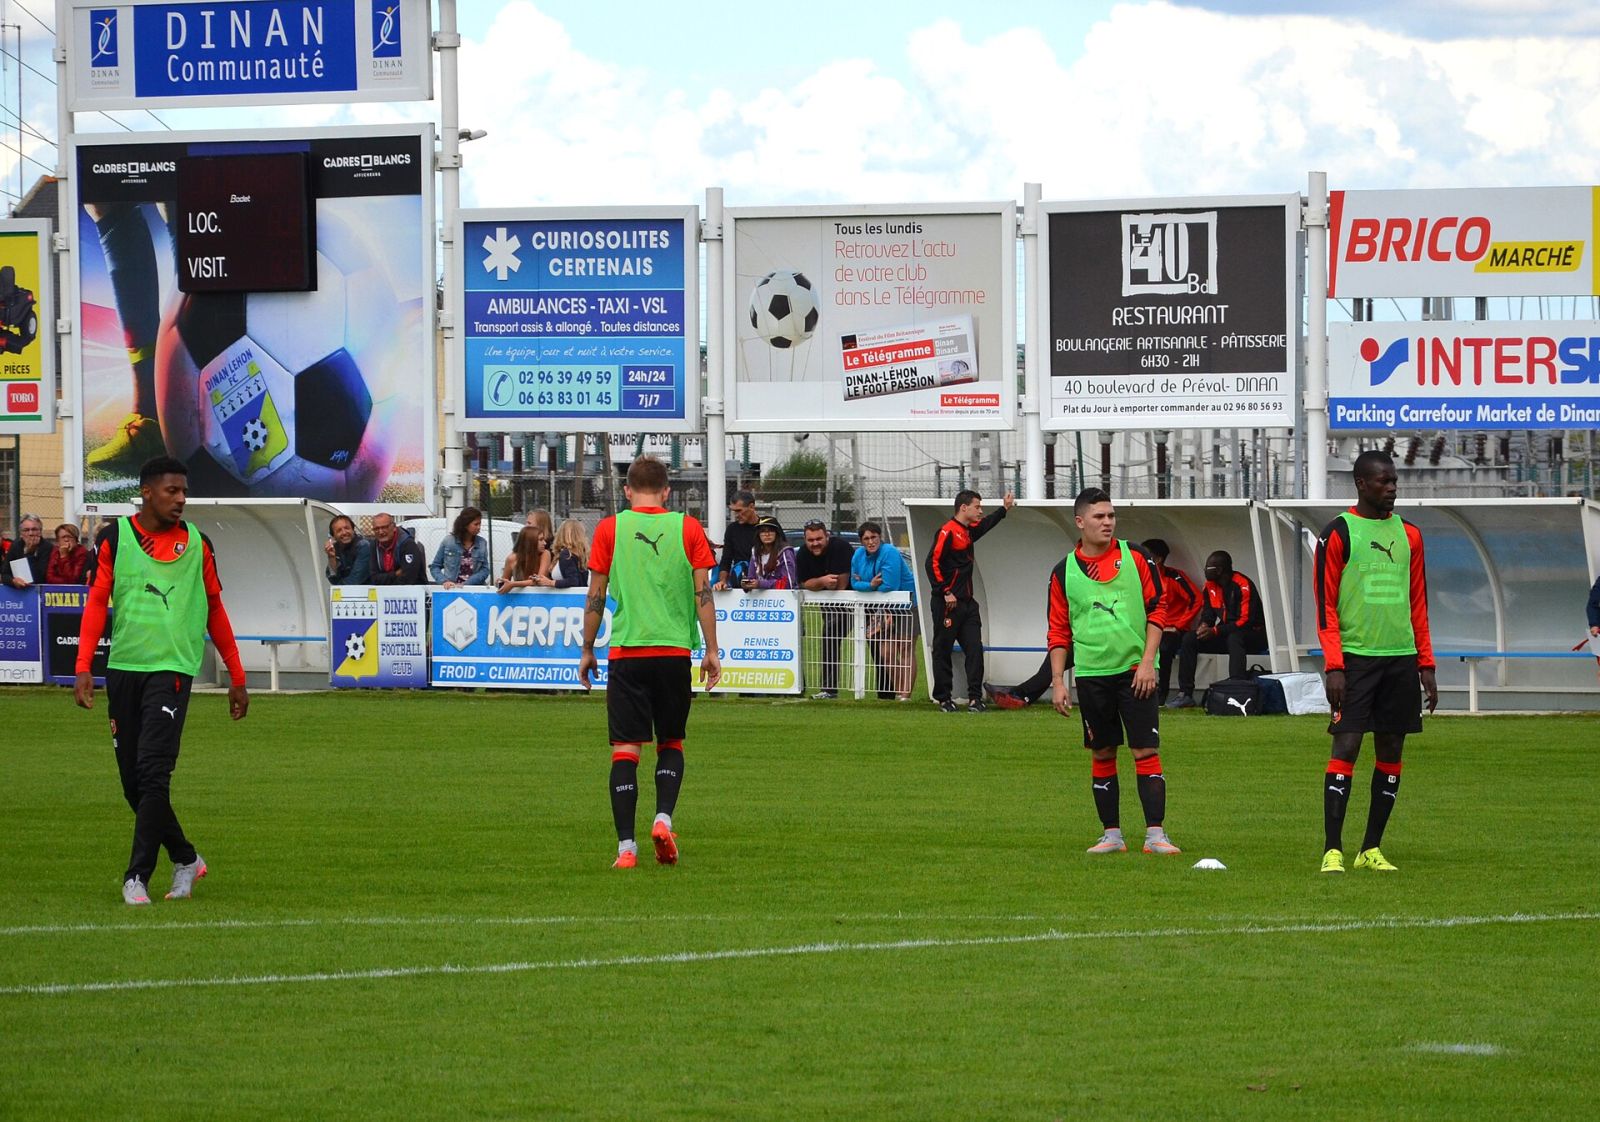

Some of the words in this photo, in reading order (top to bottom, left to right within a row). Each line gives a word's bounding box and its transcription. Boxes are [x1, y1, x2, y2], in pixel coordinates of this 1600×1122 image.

[167, 6, 324, 50] DINAN
[167, 51, 324, 82] Communauté
[373, 60, 403, 69] DINAN
[91, 70, 120, 78] DINAN
[92, 164, 128, 174] CADRES
[140, 161, 176, 172] BLANCS
[323, 156, 360, 168] CADRES
[373, 154, 411, 165] BLANCS
[230, 194, 251, 203] Bodet
[188, 212, 222, 233] LOC.
[835, 223, 862, 235] Tous
[866, 223, 883, 234] les
[885, 221, 923, 234] lundis
[532, 230, 670, 250] CURIOSOLITES
[1132, 233, 1151, 247] LE
[1344, 216, 1491, 263] BRICO
[835, 240, 909, 259] Retrouvez
[912, 239, 957, 258] L'actu
[1489, 245, 1575, 267] MARCHÉ
[1130, 222, 1189, 282] 40
[1187, 273, 1210, 294] Bd
[187, 256, 228, 278] VISIT.
[549, 257, 653, 276] CERTENAIS
[835, 265, 853, 282] de
[857, 267, 894, 282] votre
[896, 264, 927, 281] club
[835, 288, 870, 305] dans
[873, 287, 891, 304] Le
[894, 286, 986, 308] Télégramme
[487, 298, 587, 315] AMBULANCES
[598, 298, 630, 314] TAXI
[641, 297, 668, 314] VSL
[1112, 304, 1229, 326] RESTAURANT
[474, 321, 519, 335] Transport
[521, 322, 543, 333] assis
[545, 322, 553, 333] &
[555, 321, 592, 335] allongé
[600, 321, 631, 333] Toutes
[633, 320, 680, 332] distances
[935, 339, 954, 348] Dinan
[1056, 337, 1133, 353] BOULANGERIE
[1136, 335, 1208, 351] ARTISANALE
[1220, 332, 1287, 348] PÂTISSERIE
[484, 346, 503, 356] Une
[563, 345, 574, 356] et
[577, 346, 596, 356] nuit
[600, 345, 607, 356] à
[609, 345, 635, 356] votre
[638, 345, 674, 356] service.
[846, 355, 860, 366] Le
[862, 345, 932, 364] Télégramme
[935, 346, 959, 356] Dinard
[4, 362, 30, 375] PIÈCES
[1141, 354, 1170, 368] 6H30
[1182, 354, 1200, 367] 21H
[205, 367, 229, 391] DINAN
[227, 348, 254, 375] LEHON
[628, 370, 666, 383] 24h/24
[846, 366, 918, 387] DINAN-LÉHON
[228, 374, 239, 387] FC
[519, 371, 533, 385] 02
[537, 371, 553, 385] 96
[557, 371, 572, 385] 39
[576, 370, 592, 384] 49
[596, 370, 611, 384] 59
[847, 387, 861, 398] LE
[862, 384, 887, 396] FOOT
[891, 375, 935, 391] PASSION
[1064, 380, 1082, 395] 40
[1087, 378, 1155, 394] boulevard
[1160, 379, 1177, 393] de
[1235, 377, 1279, 392] DINAN
[10, 393, 34, 403] TORO
[519, 391, 533, 405] 06
[538, 391, 553, 405] 63
[557, 391, 572, 405] 83
[576, 391, 591, 405] 01
[596, 391, 612, 405] 45
[638, 394, 660, 408] 7j/7
[943, 396, 953, 404] Le
[1063, 404, 1079, 414] Plat
[1081, 404, 1091, 413] du
[1093, 405, 1111, 414] Jour
[1112, 403, 1118, 413] à
[1119, 403, 1158, 414] emporter
[1160, 402, 1209, 412] commander
[1211, 404, 1222, 412] au
[1223, 402, 1234, 411] 02
[1235, 402, 1246, 411] 96
[1247, 402, 1259, 411] 80
[1260, 402, 1271, 411] 56
[1272, 402, 1283, 411] 93
[1336, 404, 1396, 426] Parking
[1399, 404, 1473, 422] Carrefour
[1475, 403, 1532, 422] Market
[1536, 403, 1556, 422] de
[45, 592, 80, 607] DINAN
[384, 599, 418, 615] DINAN
[739, 599, 751, 608] ST
[752, 599, 786, 608] BRIEUC
[733, 612, 743, 621] 02
[745, 612, 756, 621] 96
[757, 612, 767, 621] 52
[769, 612, 779, 621] 53
[781, 612, 792, 621] 32
[5, 627, 15, 636] 23
[16, 627, 26, 636] 23
[384, 621, 418, 638] LEHON
[487, 606, 613, 648] KERFRO
[6, 641, 16, 649] 23
[57, 636, 80, 646] CADR
[744, 638, 779, 647] RENNES
[381, 642, 423, 657] FOOTBALL
[732, 650, 743, 660] 02
[745, 650, 755, 660] 99
[756, 651, 767, 660] 26
[768, 651, 778, 660] 15
[780, 651, 791, 660] 78
[391, 660, 413, 676] CLUB
[439, 665, 477, 680] FROID
[488, 666, 581, 682] CLIMATISATION
[698, 672, 787, 686] OTHERMIE
[616, 784, 634, 792] SRFC
